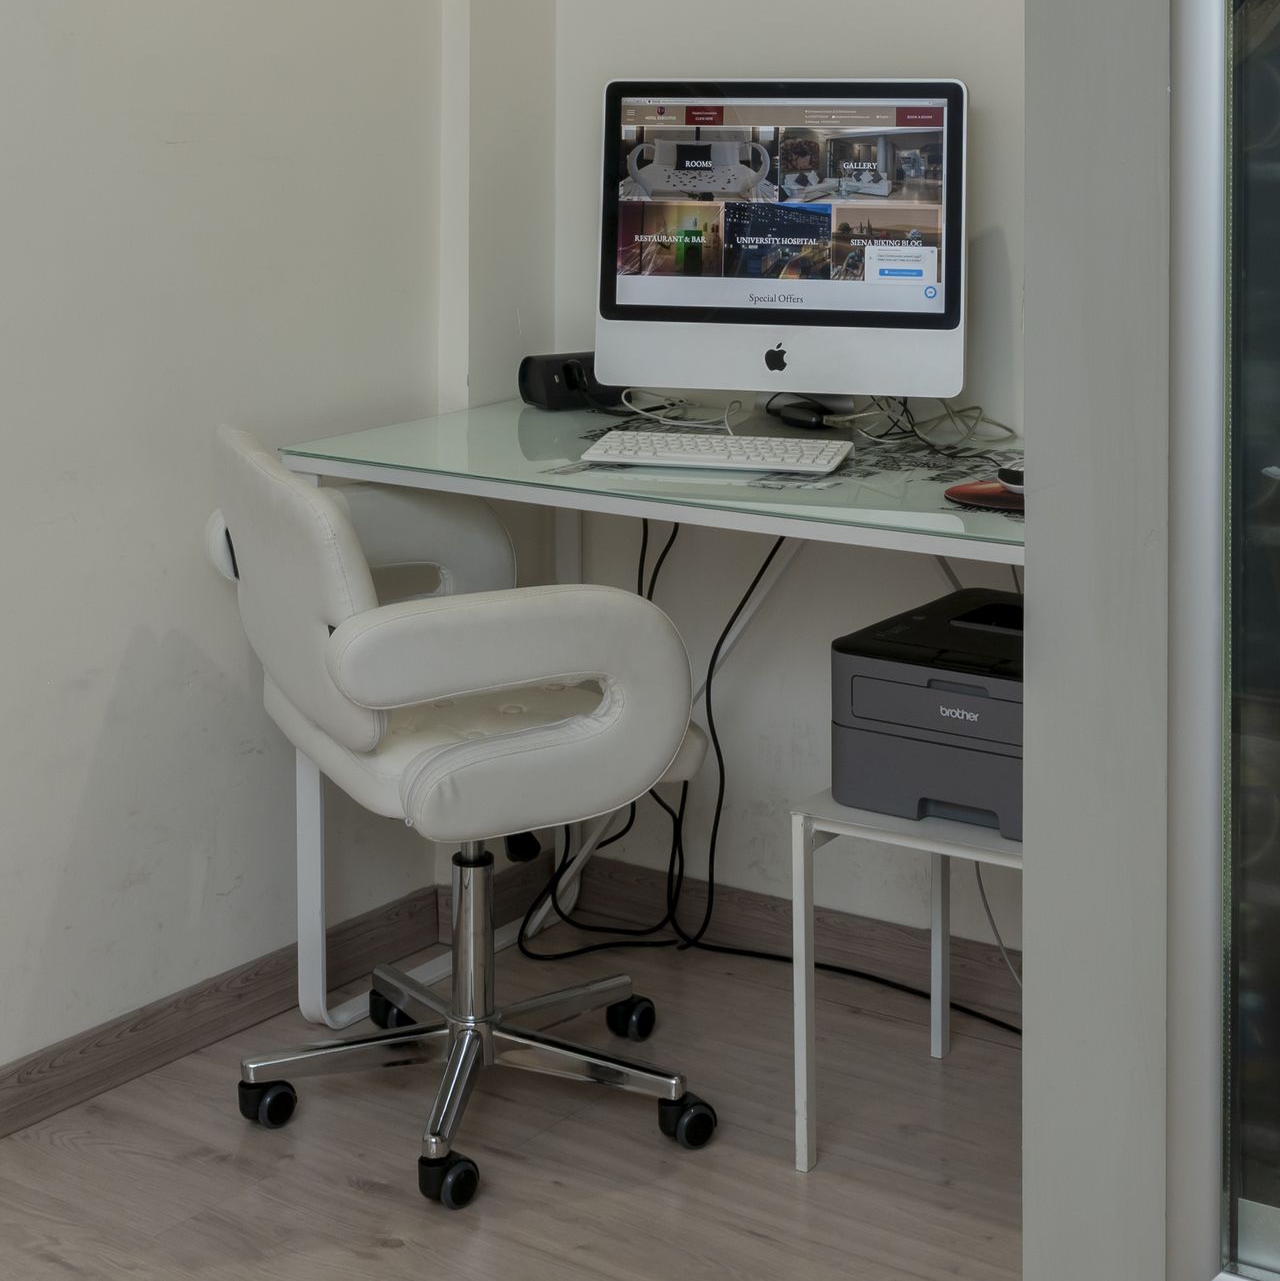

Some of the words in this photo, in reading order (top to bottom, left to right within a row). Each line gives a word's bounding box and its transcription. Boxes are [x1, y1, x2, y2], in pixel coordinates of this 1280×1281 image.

[685, 160, 712, 168] ROOMS
[843, 162, 878, 170] GALLERY
[634, 235, 683, 243] RESTAURANT
[736, 236, 780, 245] UNIVERSITY
[781, 237, 818, 246] HOSPITAL
[850, 239, 872, 247] SIENA
[874, 239, 900, 247] BIKING
[749, 293, 776, 305] Special
[778, 294, 804, 303] Offers
[939, 705, 980, 723] brother
